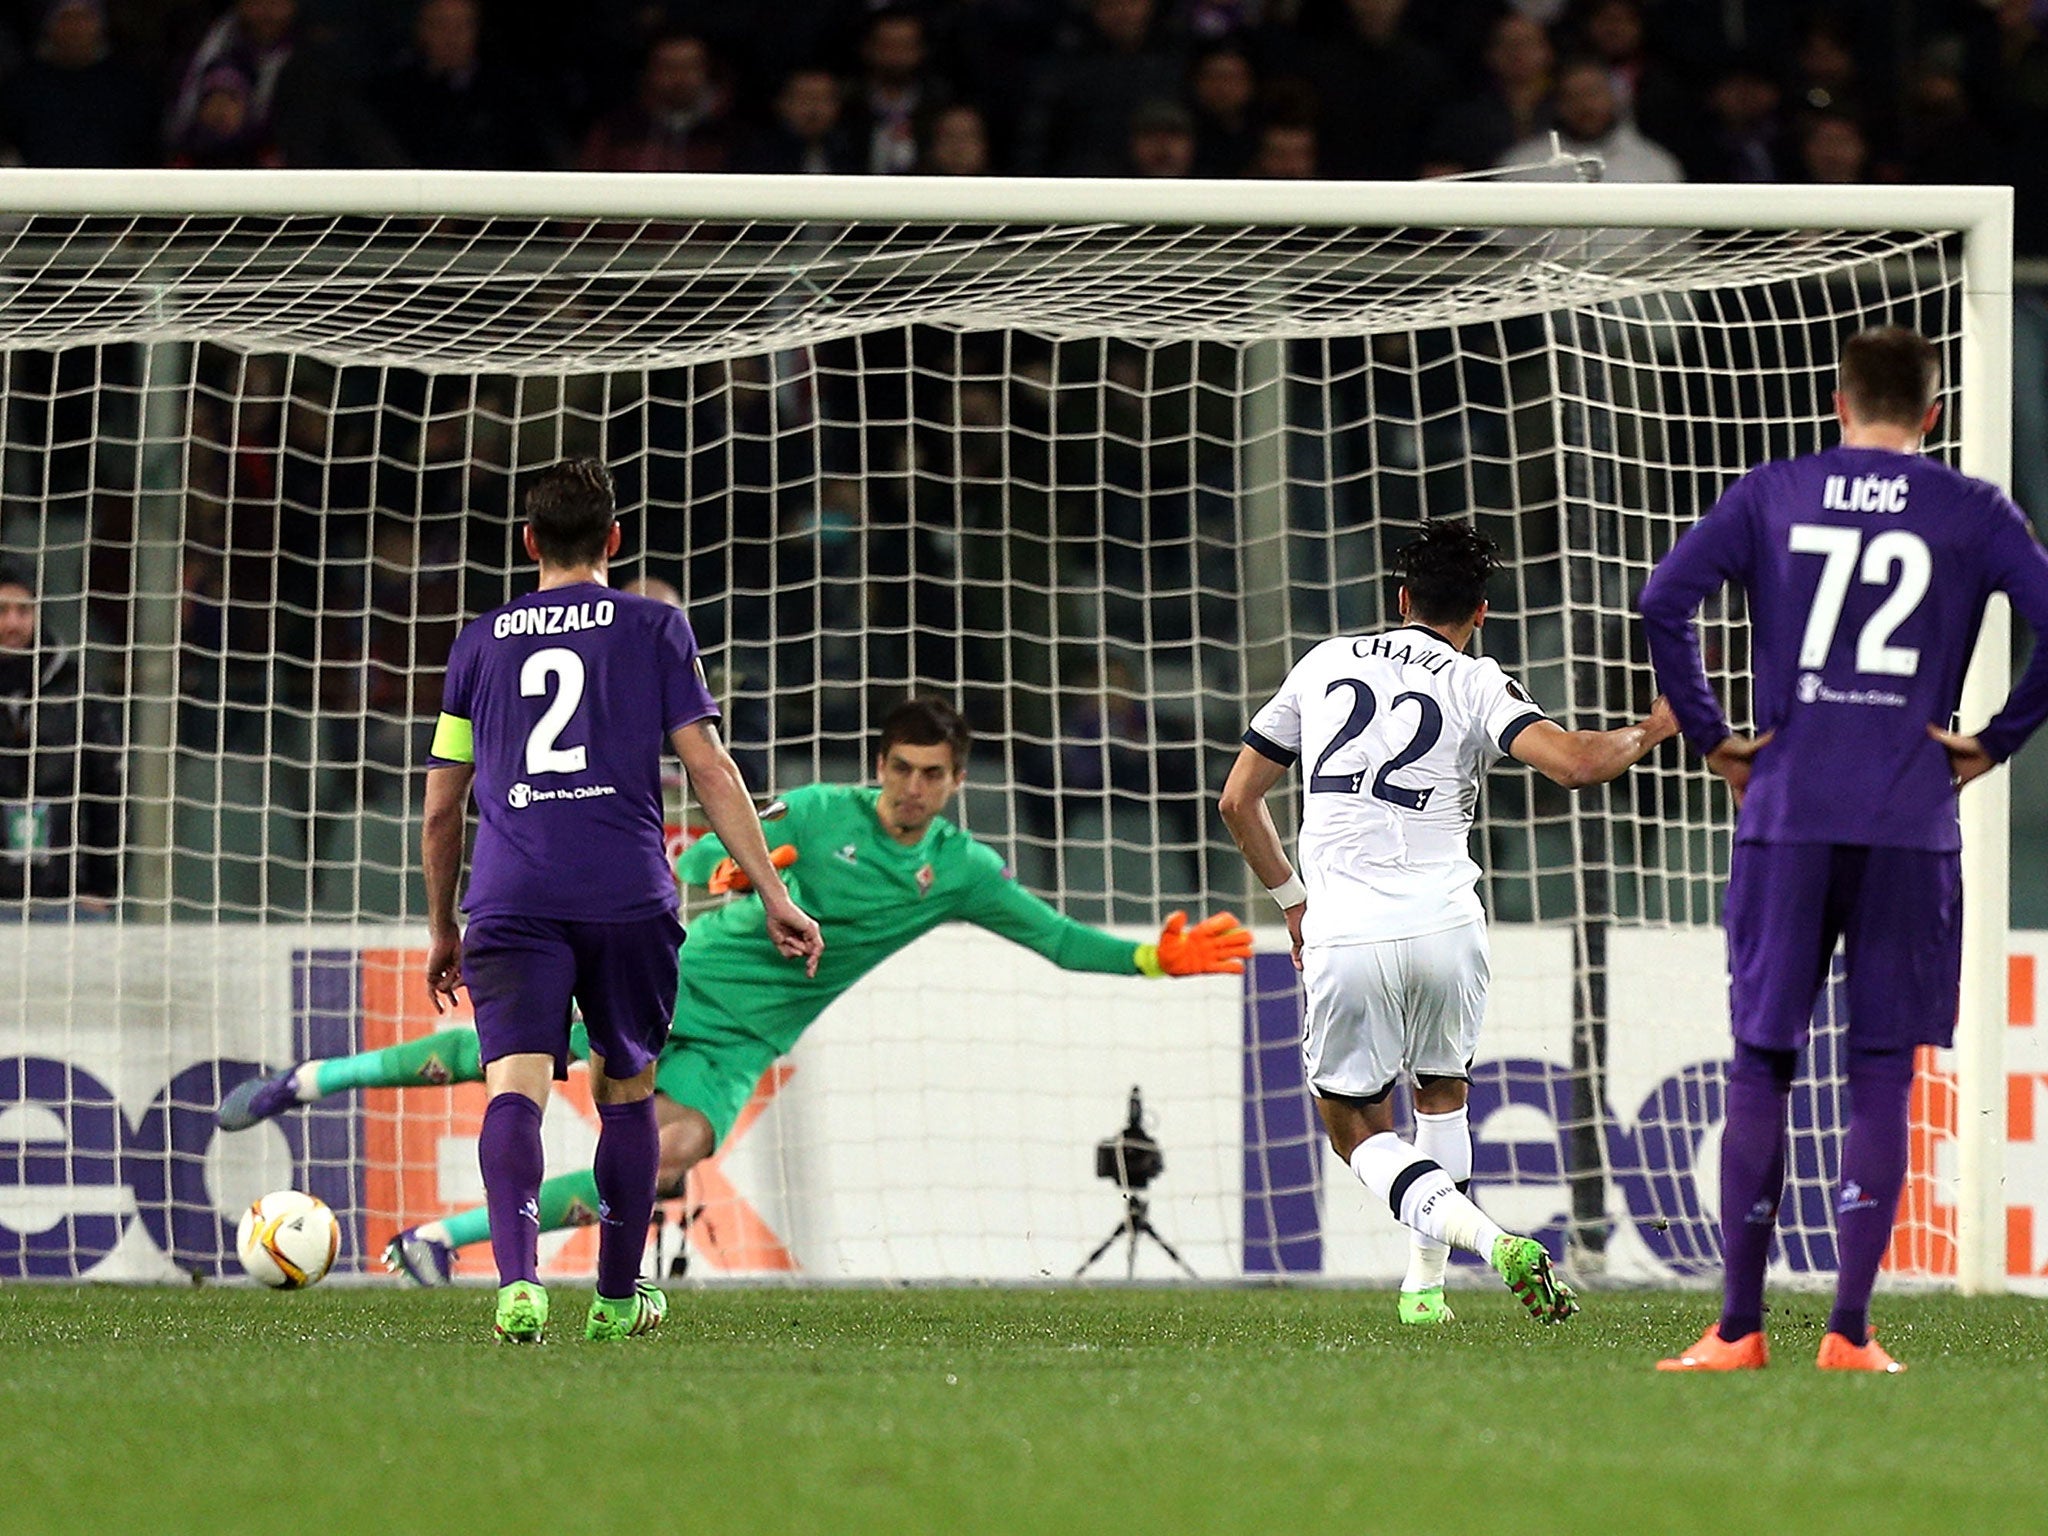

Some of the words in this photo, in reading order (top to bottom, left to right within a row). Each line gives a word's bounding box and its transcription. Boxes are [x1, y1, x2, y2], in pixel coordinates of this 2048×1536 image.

[1823, 473, 1909, 513] ILIČIĆ
[494, 600, 615, 639] GONZALO
[1788, 523, 1933, 677] 72
[1352, 638, 1453, 676] CHADLI
[520, 647, 588, 775] 2
[1310, 678, 1444, 812] 22
